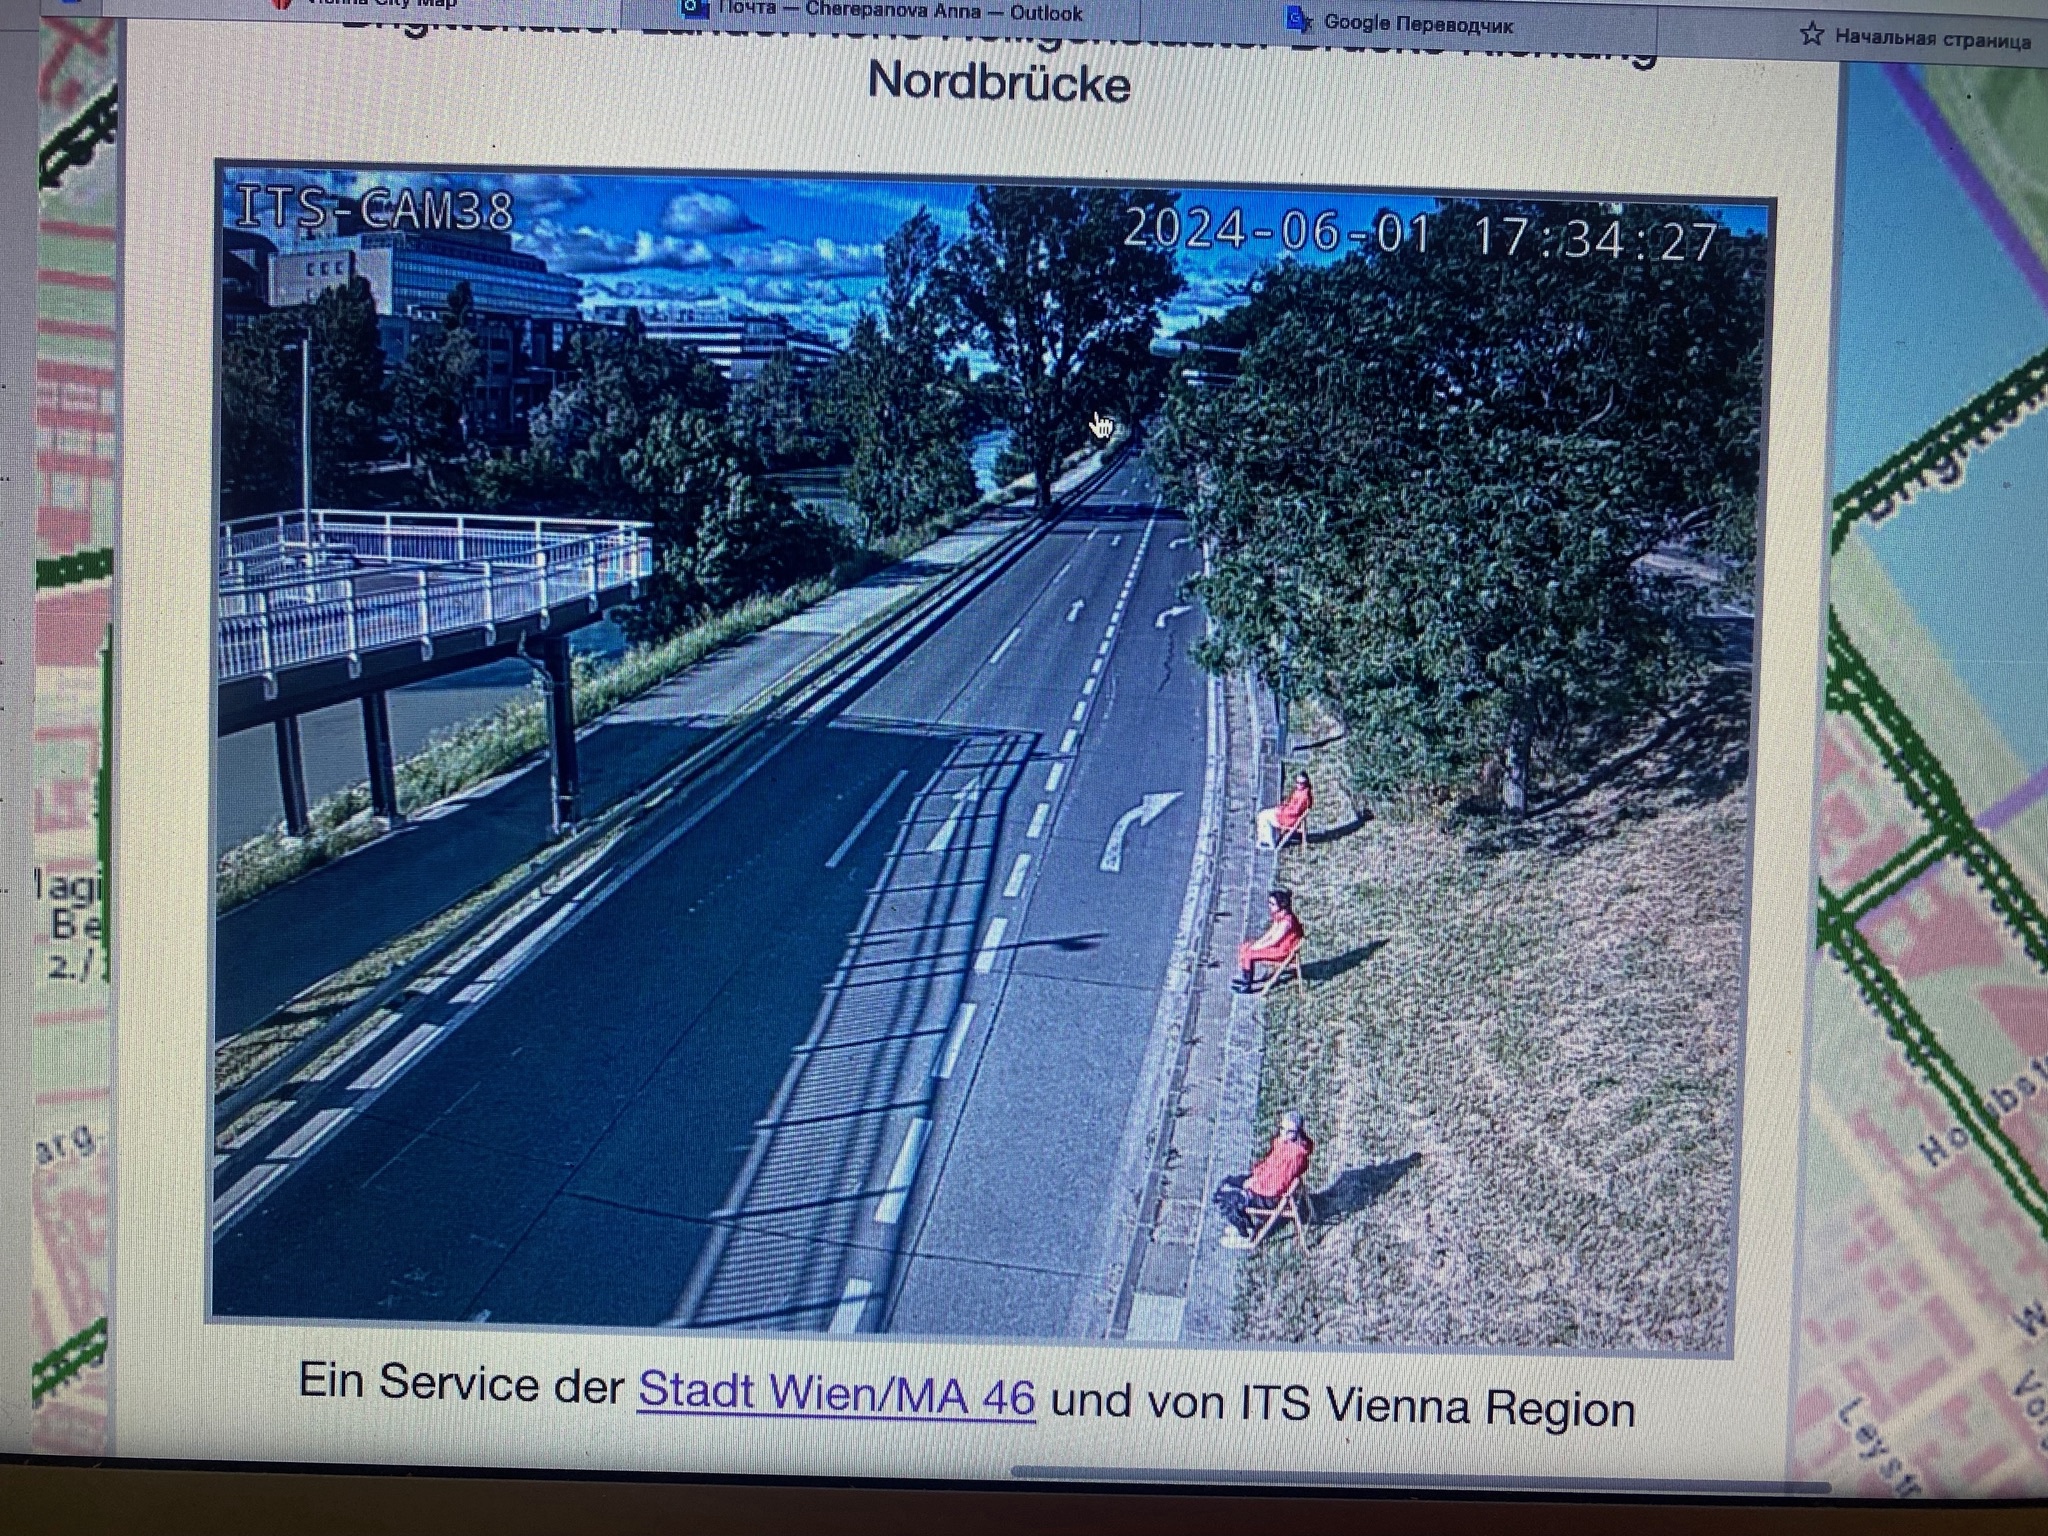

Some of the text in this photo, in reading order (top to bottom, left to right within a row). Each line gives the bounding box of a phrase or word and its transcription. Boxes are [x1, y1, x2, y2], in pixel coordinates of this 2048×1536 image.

[720, 0, 776, 14] Почта
[806, 0, 927, 20] Cherepanova
[934, 3, 981, 19] Anna
[1010, 4, 1083, 21] Outlook
[1324, 13, 1514, 36] Google Переводчик
[1836, 27, 2032, 51] Начальная страница
[869, 58, 1131, 103] Nordbrücke
[236, 185, 514, 232] ITS-CAM38
[1122, 206, 1719, 262] 2024-06-01 17:34:27
[300, 1360, 1635, 1436] Ein Service der Stadt Wien/MA 46 und von ITS Vienna Region
